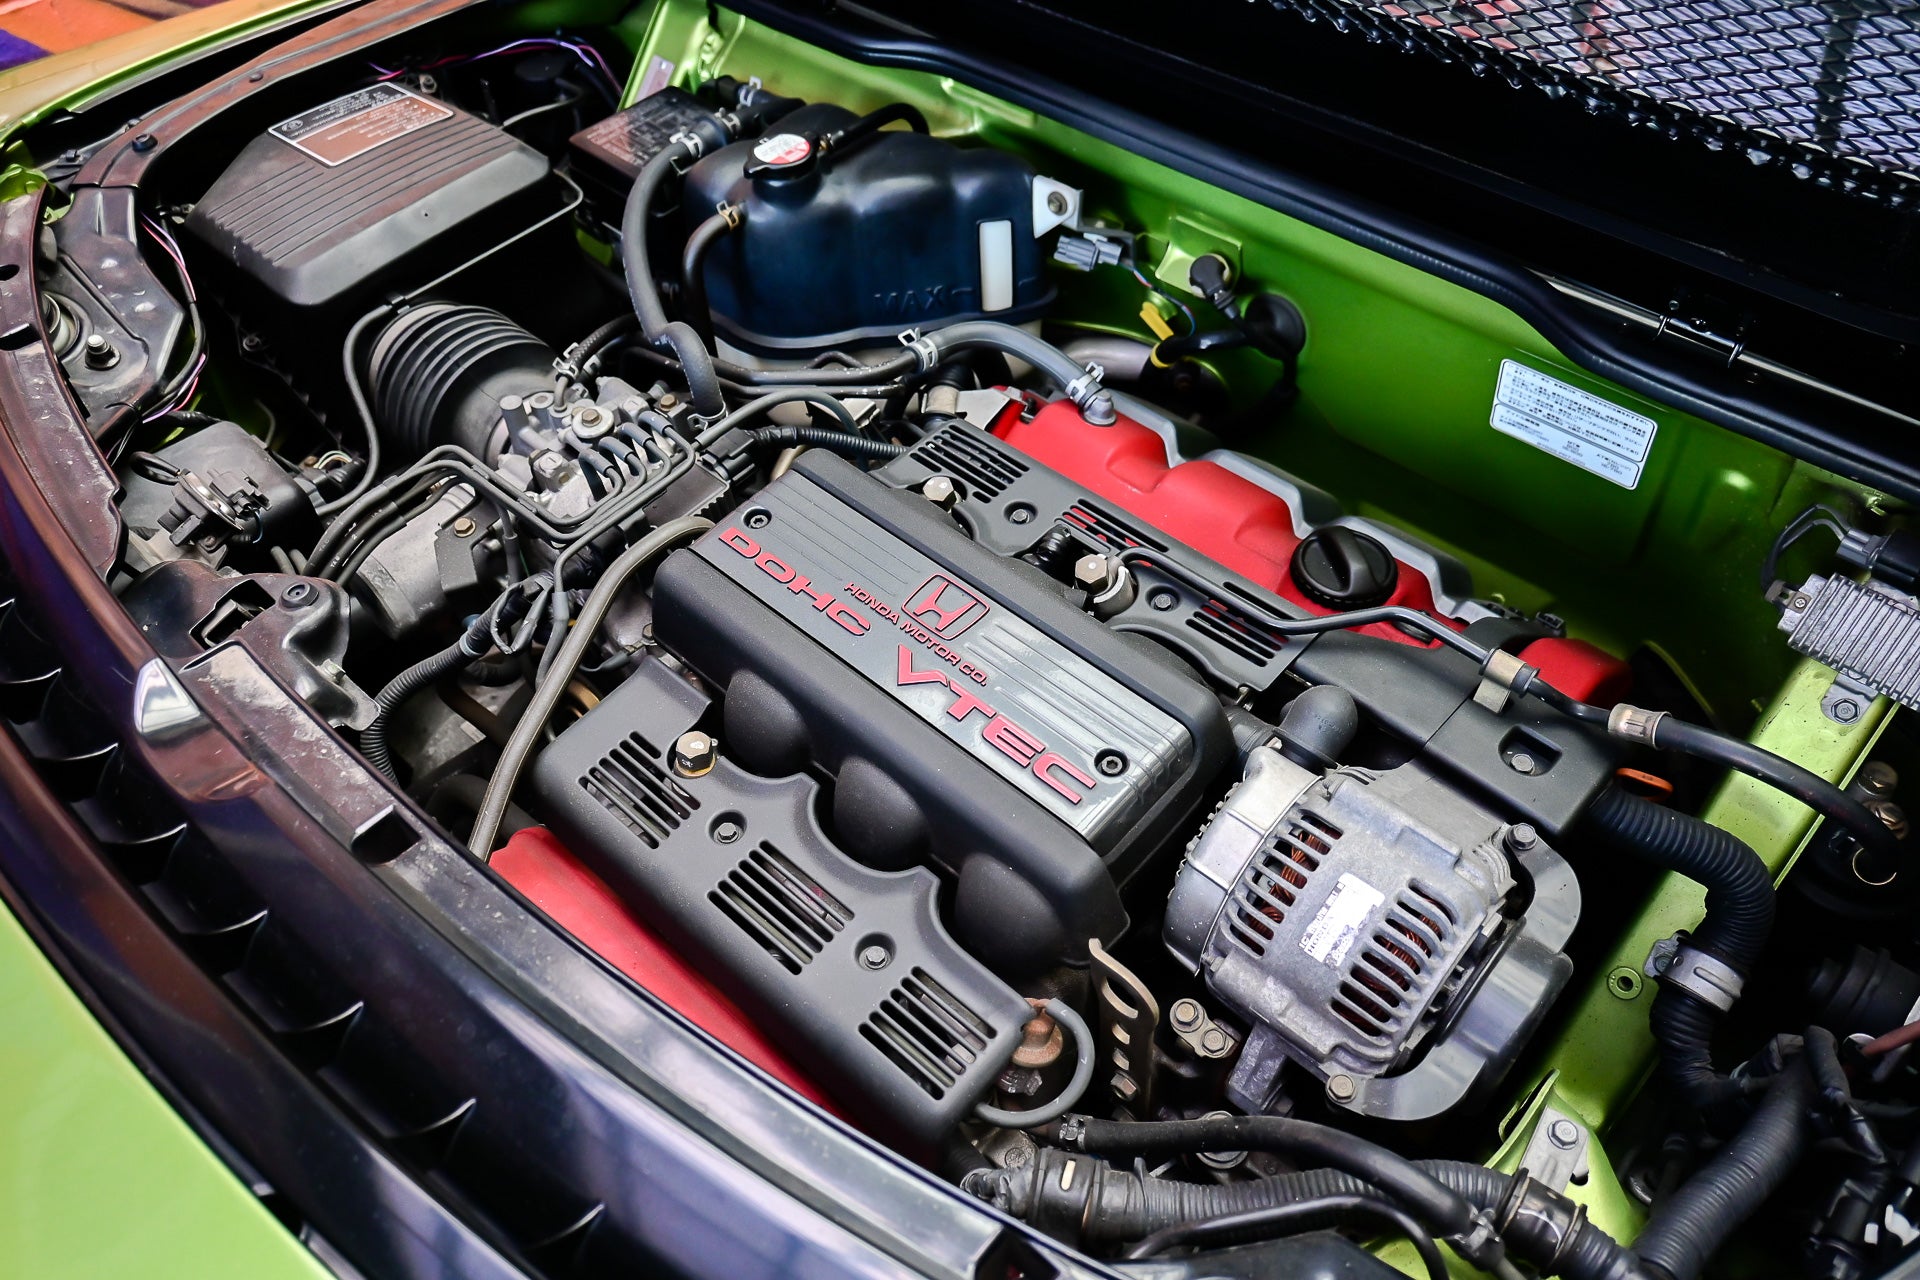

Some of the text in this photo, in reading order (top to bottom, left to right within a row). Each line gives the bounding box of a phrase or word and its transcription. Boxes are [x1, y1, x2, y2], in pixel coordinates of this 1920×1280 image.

[718, 526, 871, 637] DOHC
[843, 581, 988, 687] HONDA MOTOR CO.
[896, 643, 1097, 805] VTEC
